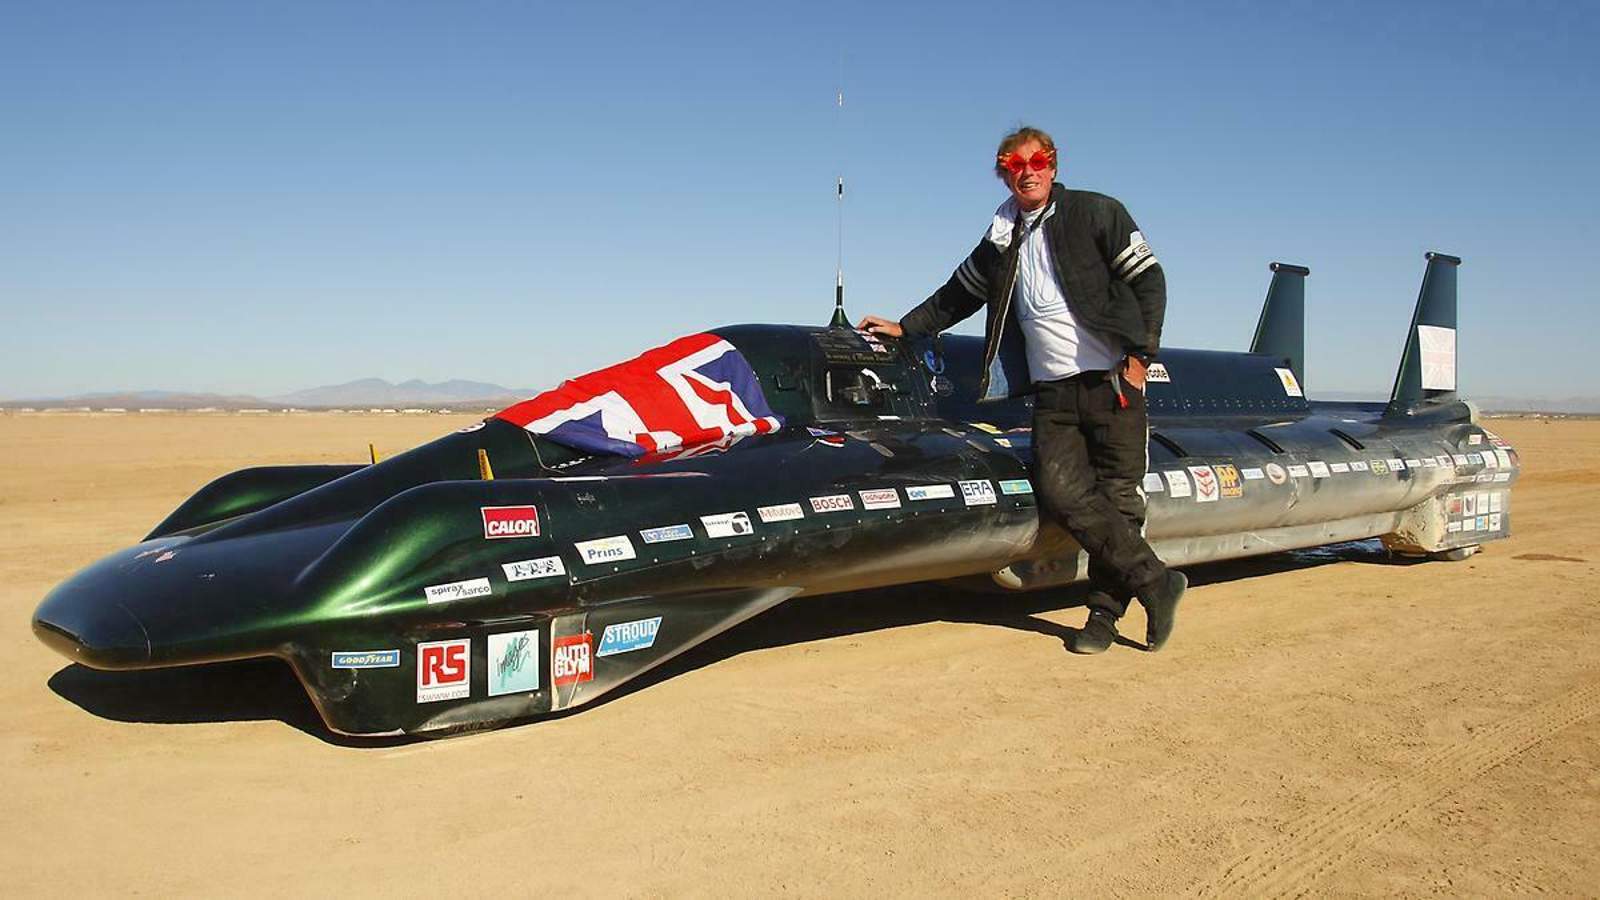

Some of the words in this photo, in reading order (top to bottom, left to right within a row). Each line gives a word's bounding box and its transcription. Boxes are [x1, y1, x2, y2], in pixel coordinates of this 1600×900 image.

[961, 482, 994, 496] ERA
[812, 497, 852, 510] BOSCH
[488, 519, 536, 536] CALOR
[588, 546, 624, 559] Prins
[606, 621, 657, 643] STROUD
[555, 642, 589, 661] AUTO
[338, 655, 393, 665] GOODYEAR
[422, 645, 466, 686] RS
